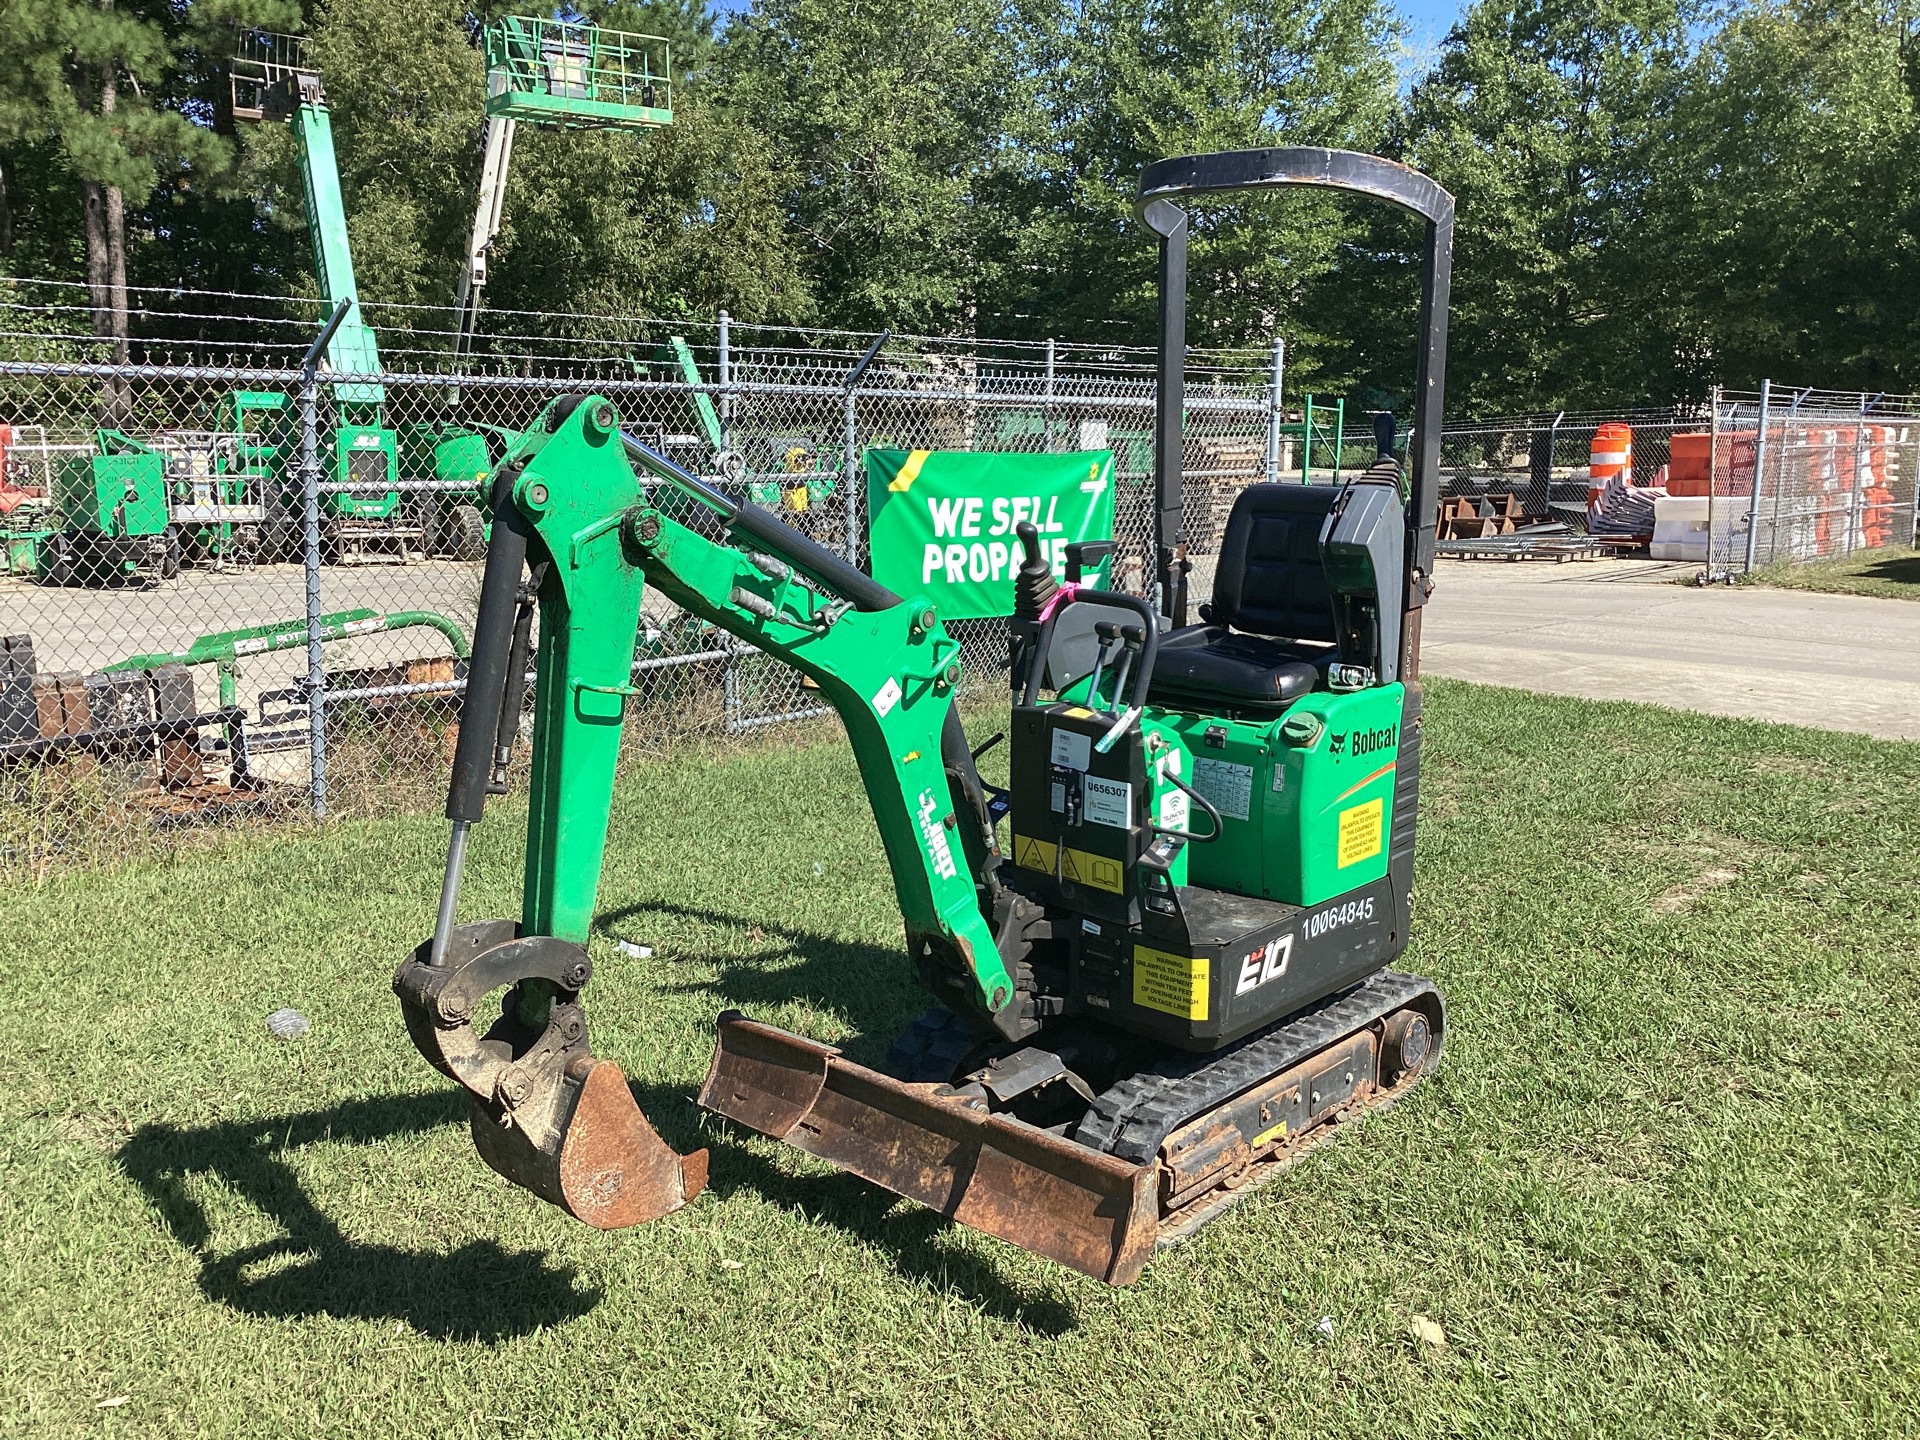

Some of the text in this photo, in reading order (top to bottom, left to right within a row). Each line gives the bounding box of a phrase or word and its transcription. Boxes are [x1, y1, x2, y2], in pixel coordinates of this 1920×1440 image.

[927, 495, 1063, 538] WE SELL
[1352, 723, 1396, 757] Bobcat
[1087, 781, 1128, 798] U656307
[916, 808, 941, 875] RENTALS
[1302, 897, 1374, 940] 10064845
[1136, 959, 1166, 972] UNLAWFUL
[1176, 970, 1206, 980] OPERATE
[1156, 956, 1183, 969] WARNING
[1234, 933, 1294, 997] E10
[1145, 979, 1194, 996] WITHIN TEN FEET
[1146, 970, 1193, 988] THIS EQUIPMENT
[1147, 995, 1191, 1013] VOLTAGE LINES
[1150, 987, 1182, 1002] OVERHEAD
[1183, 997, 1199, 1005] HIGH
